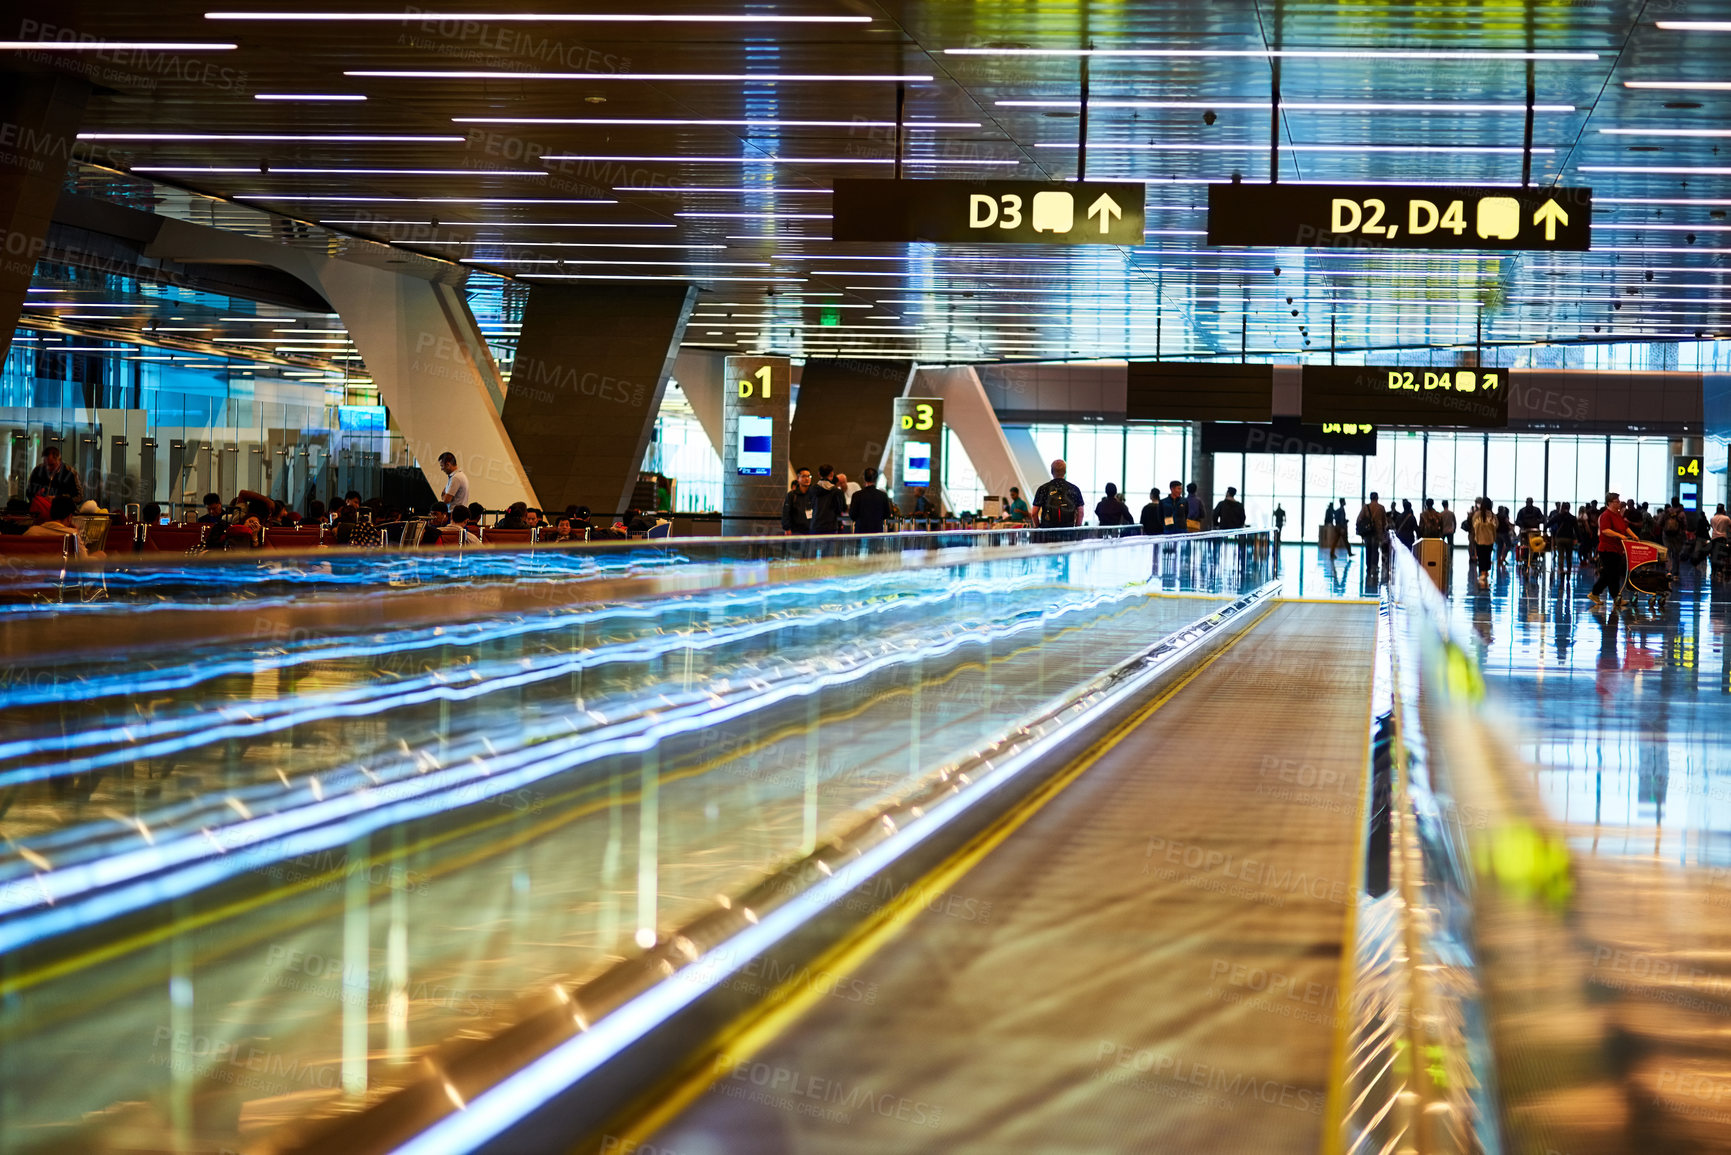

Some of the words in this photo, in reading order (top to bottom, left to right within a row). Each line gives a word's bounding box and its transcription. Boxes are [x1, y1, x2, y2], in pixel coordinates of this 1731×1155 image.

[969, 193, 1023, 230] D3
[1331, 198, 1399, 239] D2,
[1408, 199, 1467, 236] D4
[1388, 371, 1420, 392] D2,
[1424, 372, 1452, 390] D4
